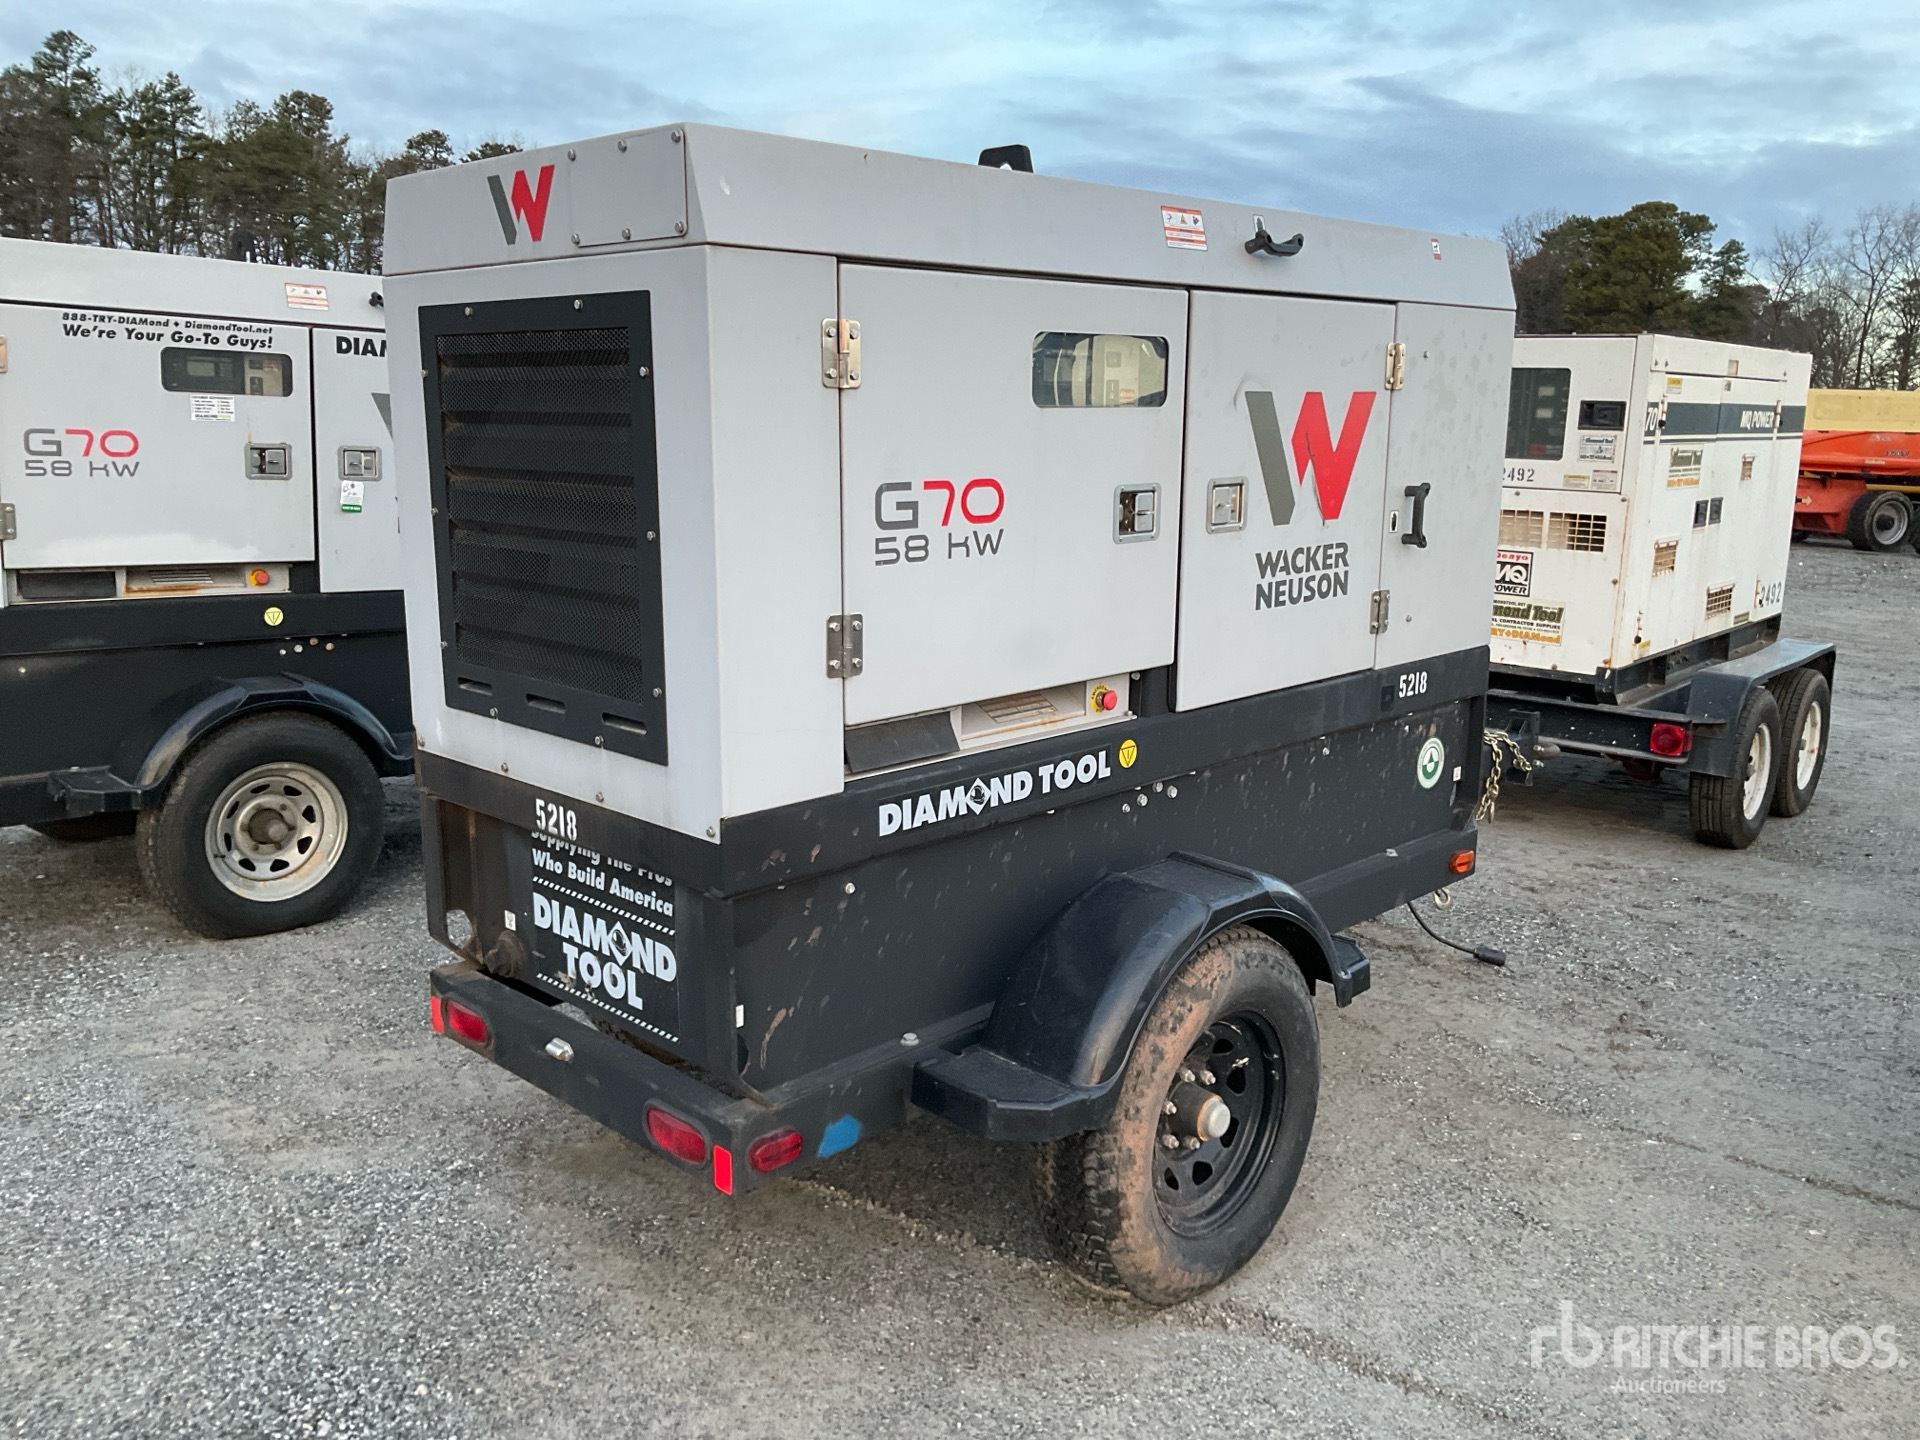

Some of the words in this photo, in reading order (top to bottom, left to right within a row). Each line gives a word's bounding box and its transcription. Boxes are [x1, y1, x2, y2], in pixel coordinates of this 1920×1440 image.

[62, 312, 169, 327] 888-TRY-DIAMond
[185, 320, 272, 334] DiamondTool.net
[62, 324, 117, 339] We're
[125, 328, 164, 342] Your
[171, 331, 220, 346] Go-To
[227, 335, 273, 350] Guys!
[1740, 410, 1752, 430] MQ
[1751, 410, 1775, 428] POWER
[24, 428, 139, 457] G70
[25, 460, 72, 477] 58
[875, 478, 1005, 530] G70
[875, 534, 930, 566] 58
[1255, 542, 1349, 579] WACKER
[1255, 570, 1349, 610] NEUSON
[1494, 584, 1527, 594] OWER
[1399, 671, 1428, 698] 5218
[1039, 750, 1111, 794] TOOL
[535, 798, 578, 841] 5218
[532, 847, 563, 874] Who
[567, 861, 606, 891] Build
[609, 877, 674, 917] America
[562, 942, 644, 1010] TOOL
